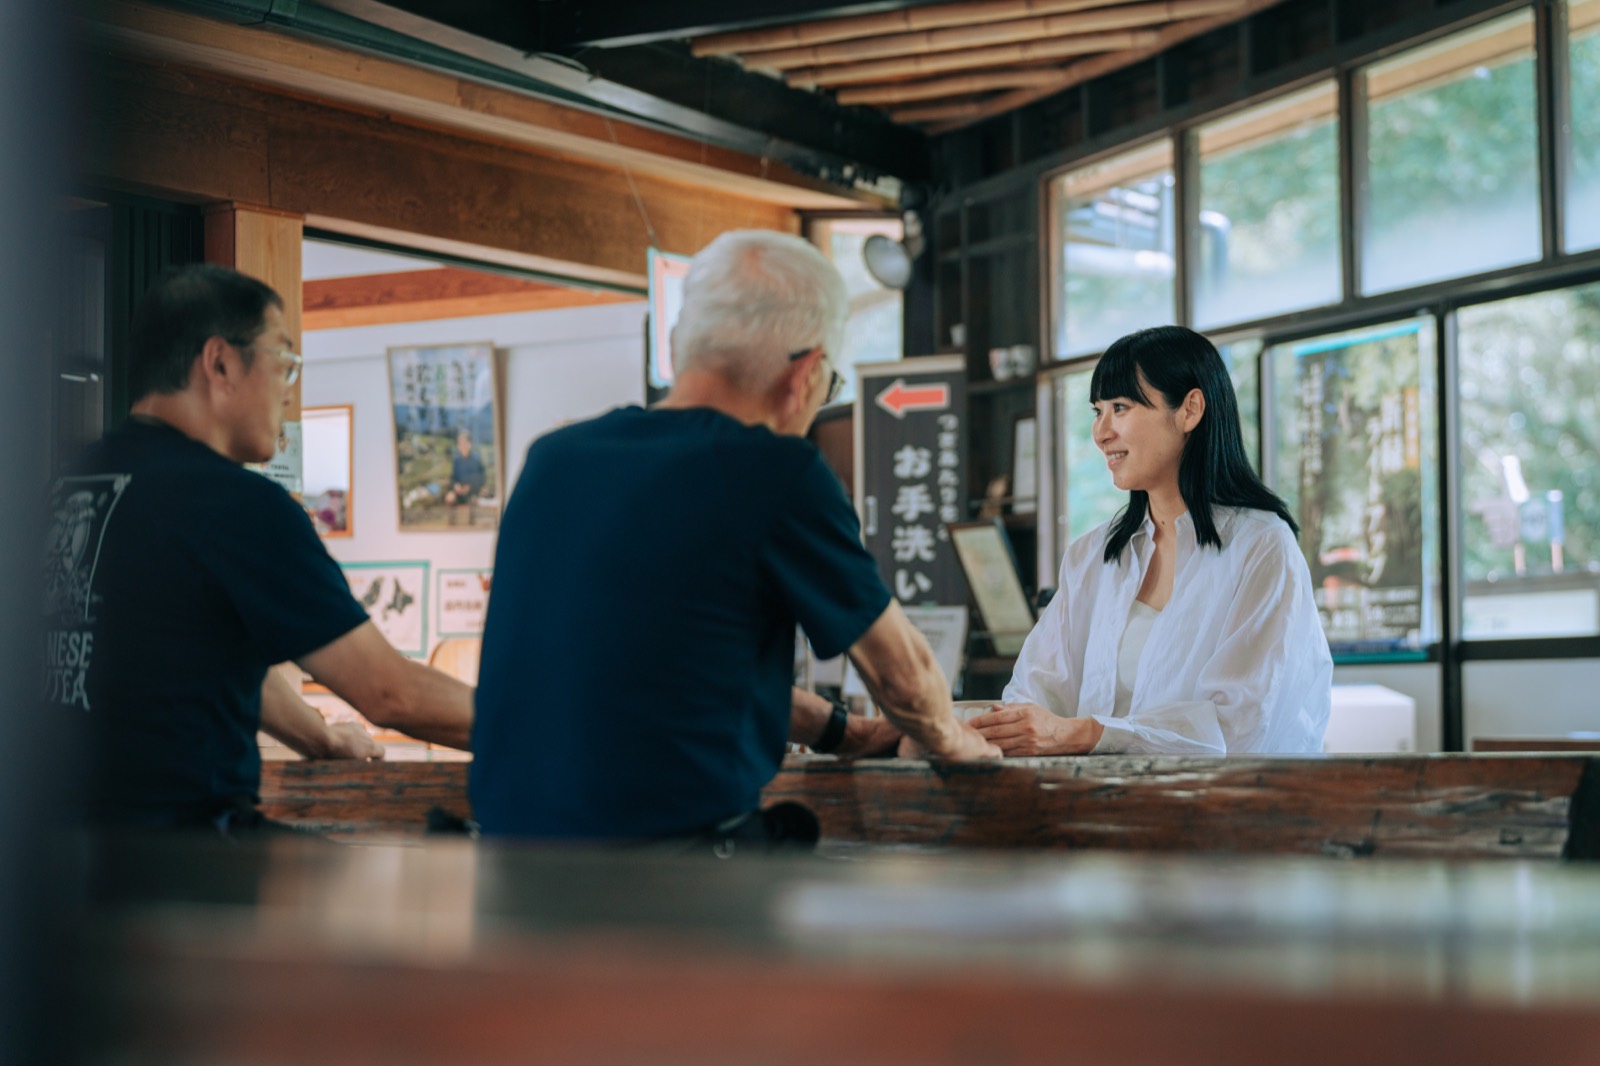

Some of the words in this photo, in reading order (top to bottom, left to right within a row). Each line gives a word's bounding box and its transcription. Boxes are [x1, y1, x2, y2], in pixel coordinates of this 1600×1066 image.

[892, 444, 936, 602] お手洗い
[45, 630, 93, 668] NESE
